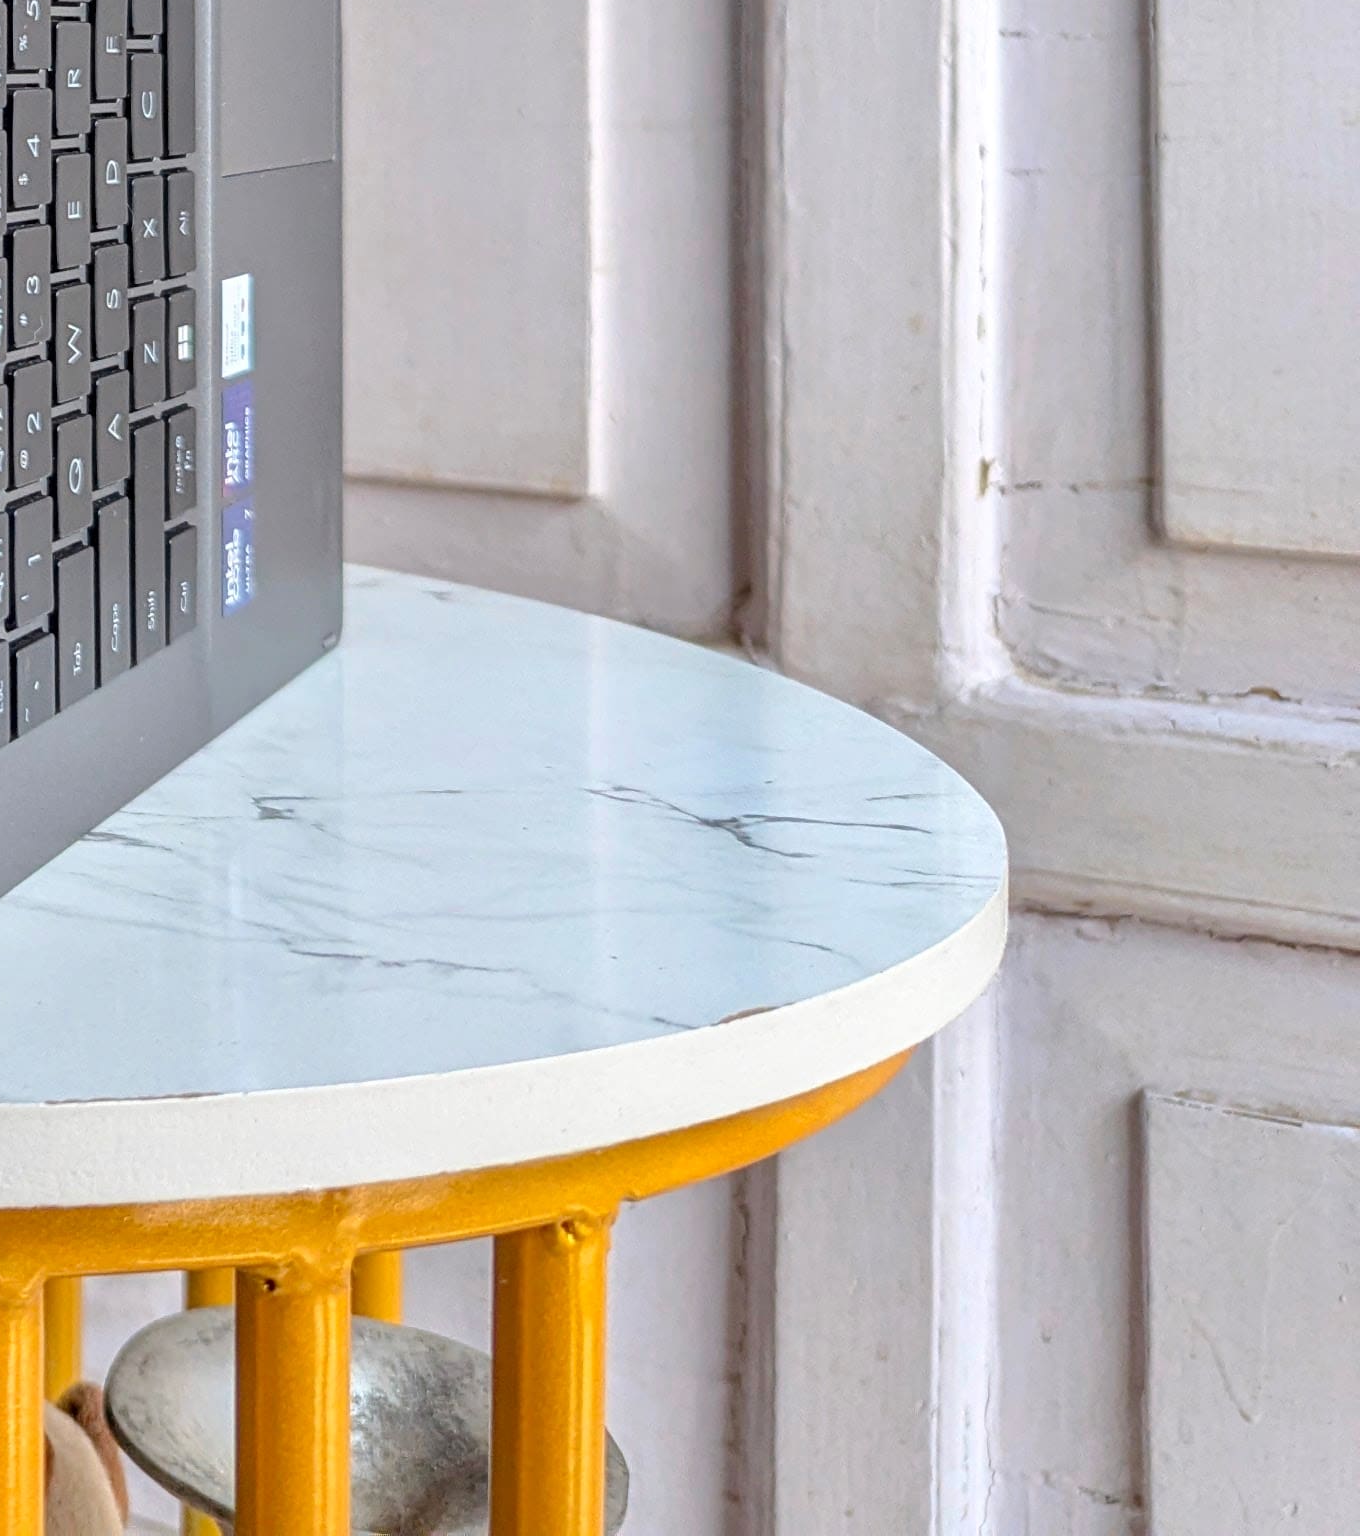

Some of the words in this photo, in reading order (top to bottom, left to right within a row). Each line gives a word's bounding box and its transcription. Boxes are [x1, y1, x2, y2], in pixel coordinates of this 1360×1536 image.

[26, 0, 40, 21] 5
[106, 36, 120, 53] F
[67, 68, 82, 88] R
[27, 135, 41, 157] 4
[106, 160, 120, 185] D
[67, 201, 81, 219] E
[142, 218, 157, 238] X
[26, 275, 40, 294] 3
[106, 289, 120, 309] S
[67, 324, 82, 363] W
[27, 411, 41, 434] 2
[108, 414, 123, 440] A
[69, 458, 82, 495] Q
[111, 603, 119, 652] Caps
[73, 642, 81, 676] Tab
